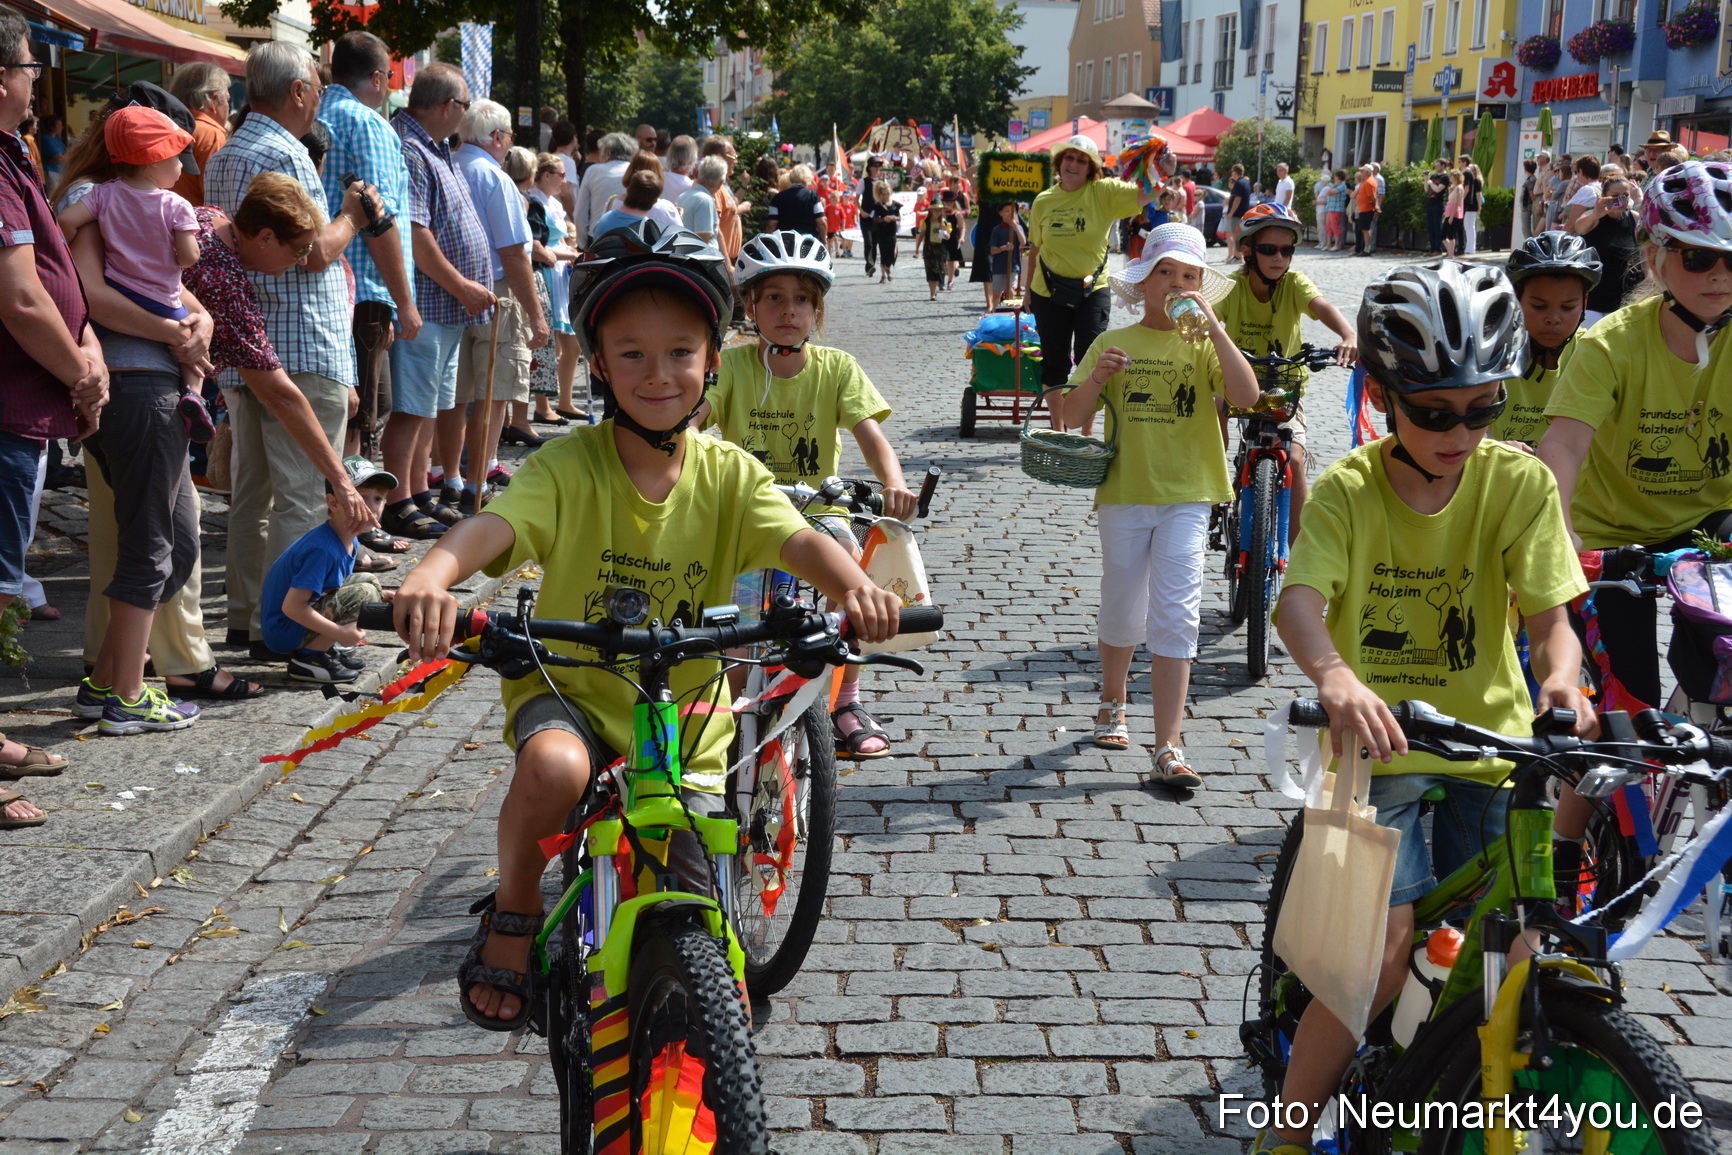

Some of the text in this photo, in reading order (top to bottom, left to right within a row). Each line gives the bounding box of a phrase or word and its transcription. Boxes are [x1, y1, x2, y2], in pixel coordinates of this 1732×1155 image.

[1530, 73, 1599, 104] APOTHEKE
[1340, 94, 1374, 111] Restaurant
[1000, 161, 1033, 173] Schule
[993, 177, 1039, 189] Wolfstein
[1125, 368, 1160, 376] Holzheim
[1128, 416, 1175, 424] Umweltschule
[1366, 672, 1447, 687] Umweltschule
